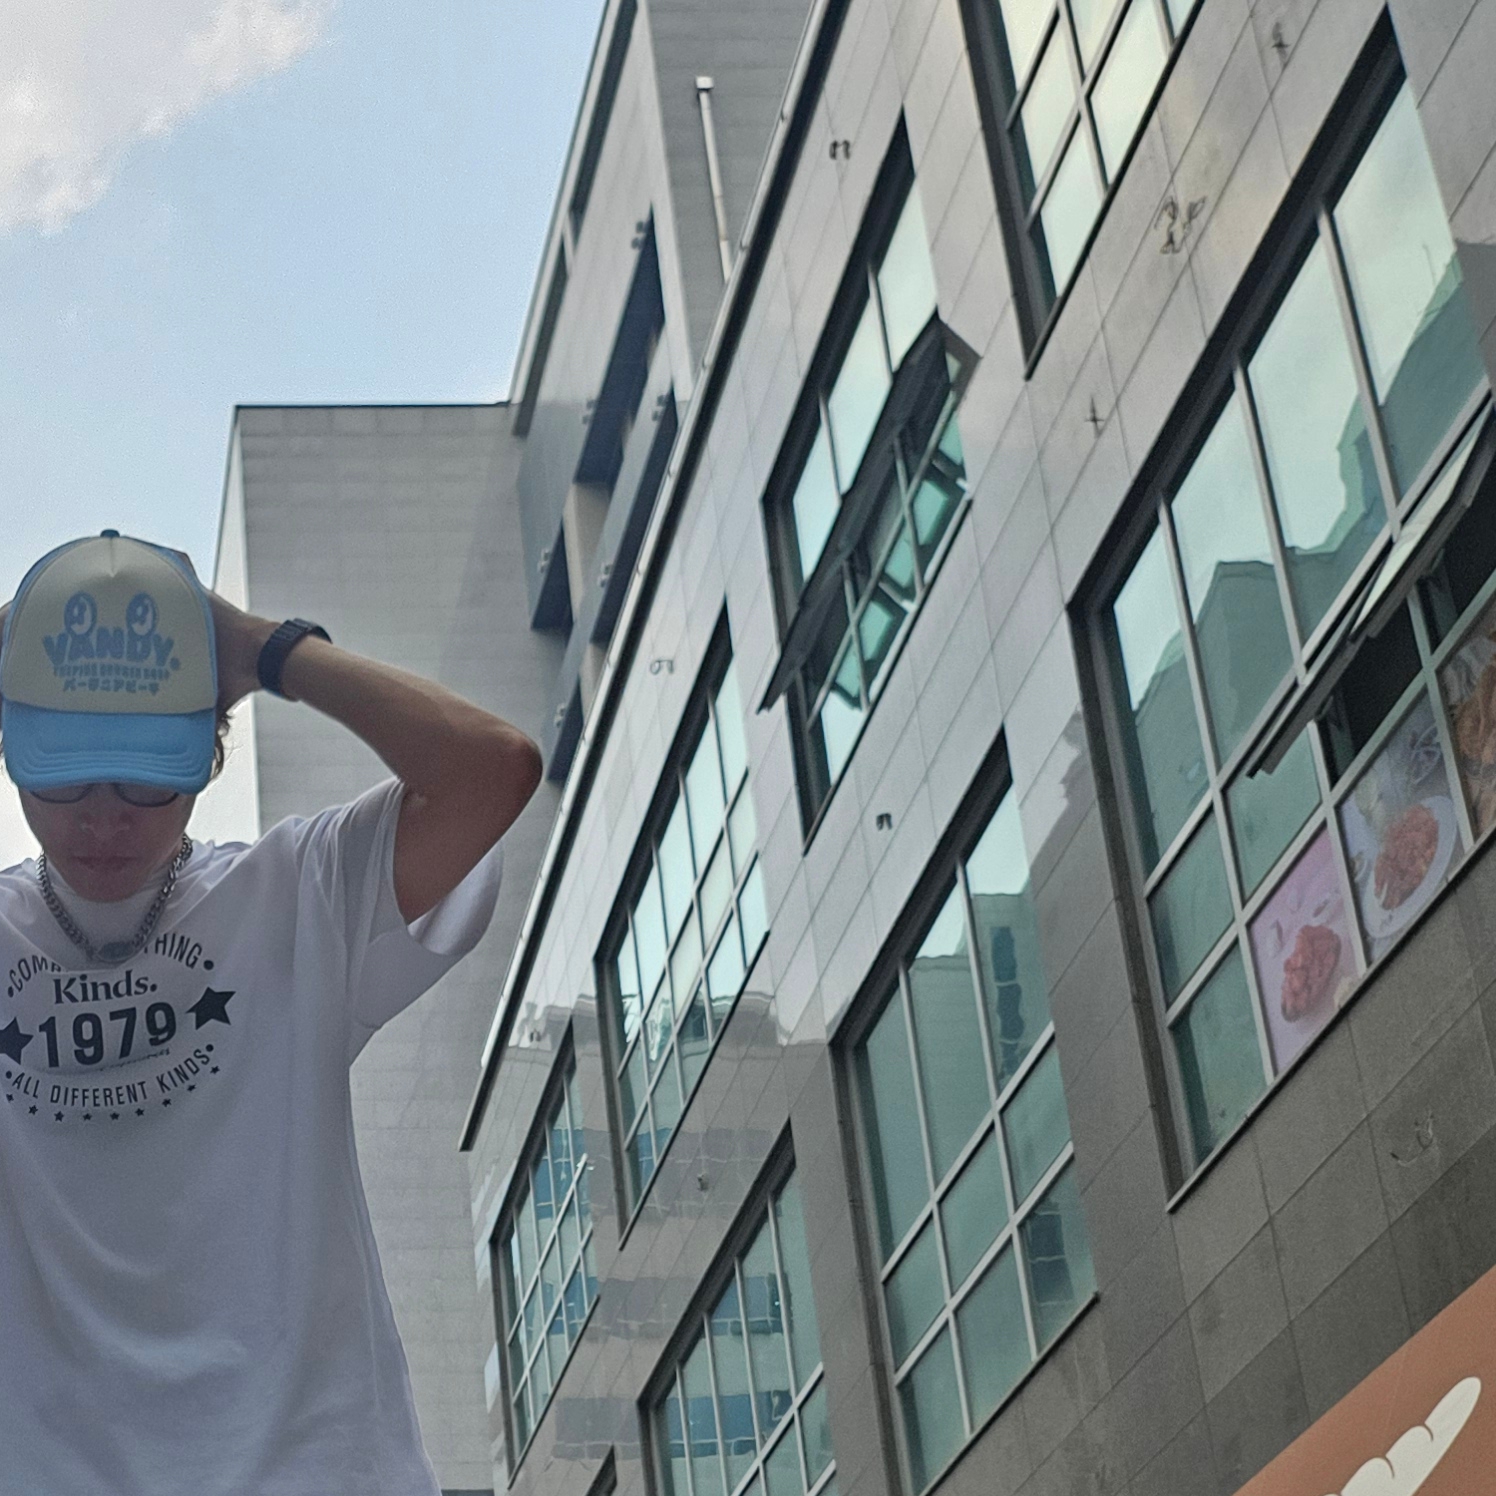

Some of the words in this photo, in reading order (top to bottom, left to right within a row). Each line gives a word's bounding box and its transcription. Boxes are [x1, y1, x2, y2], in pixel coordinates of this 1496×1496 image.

[38, 1002, 177, 1068] 1979
[11, 1071, 40, 1099] ALL
[50, 1081, 148, 1108] DIFFERENT
[156, 1048, 211, 1094] KINDS
